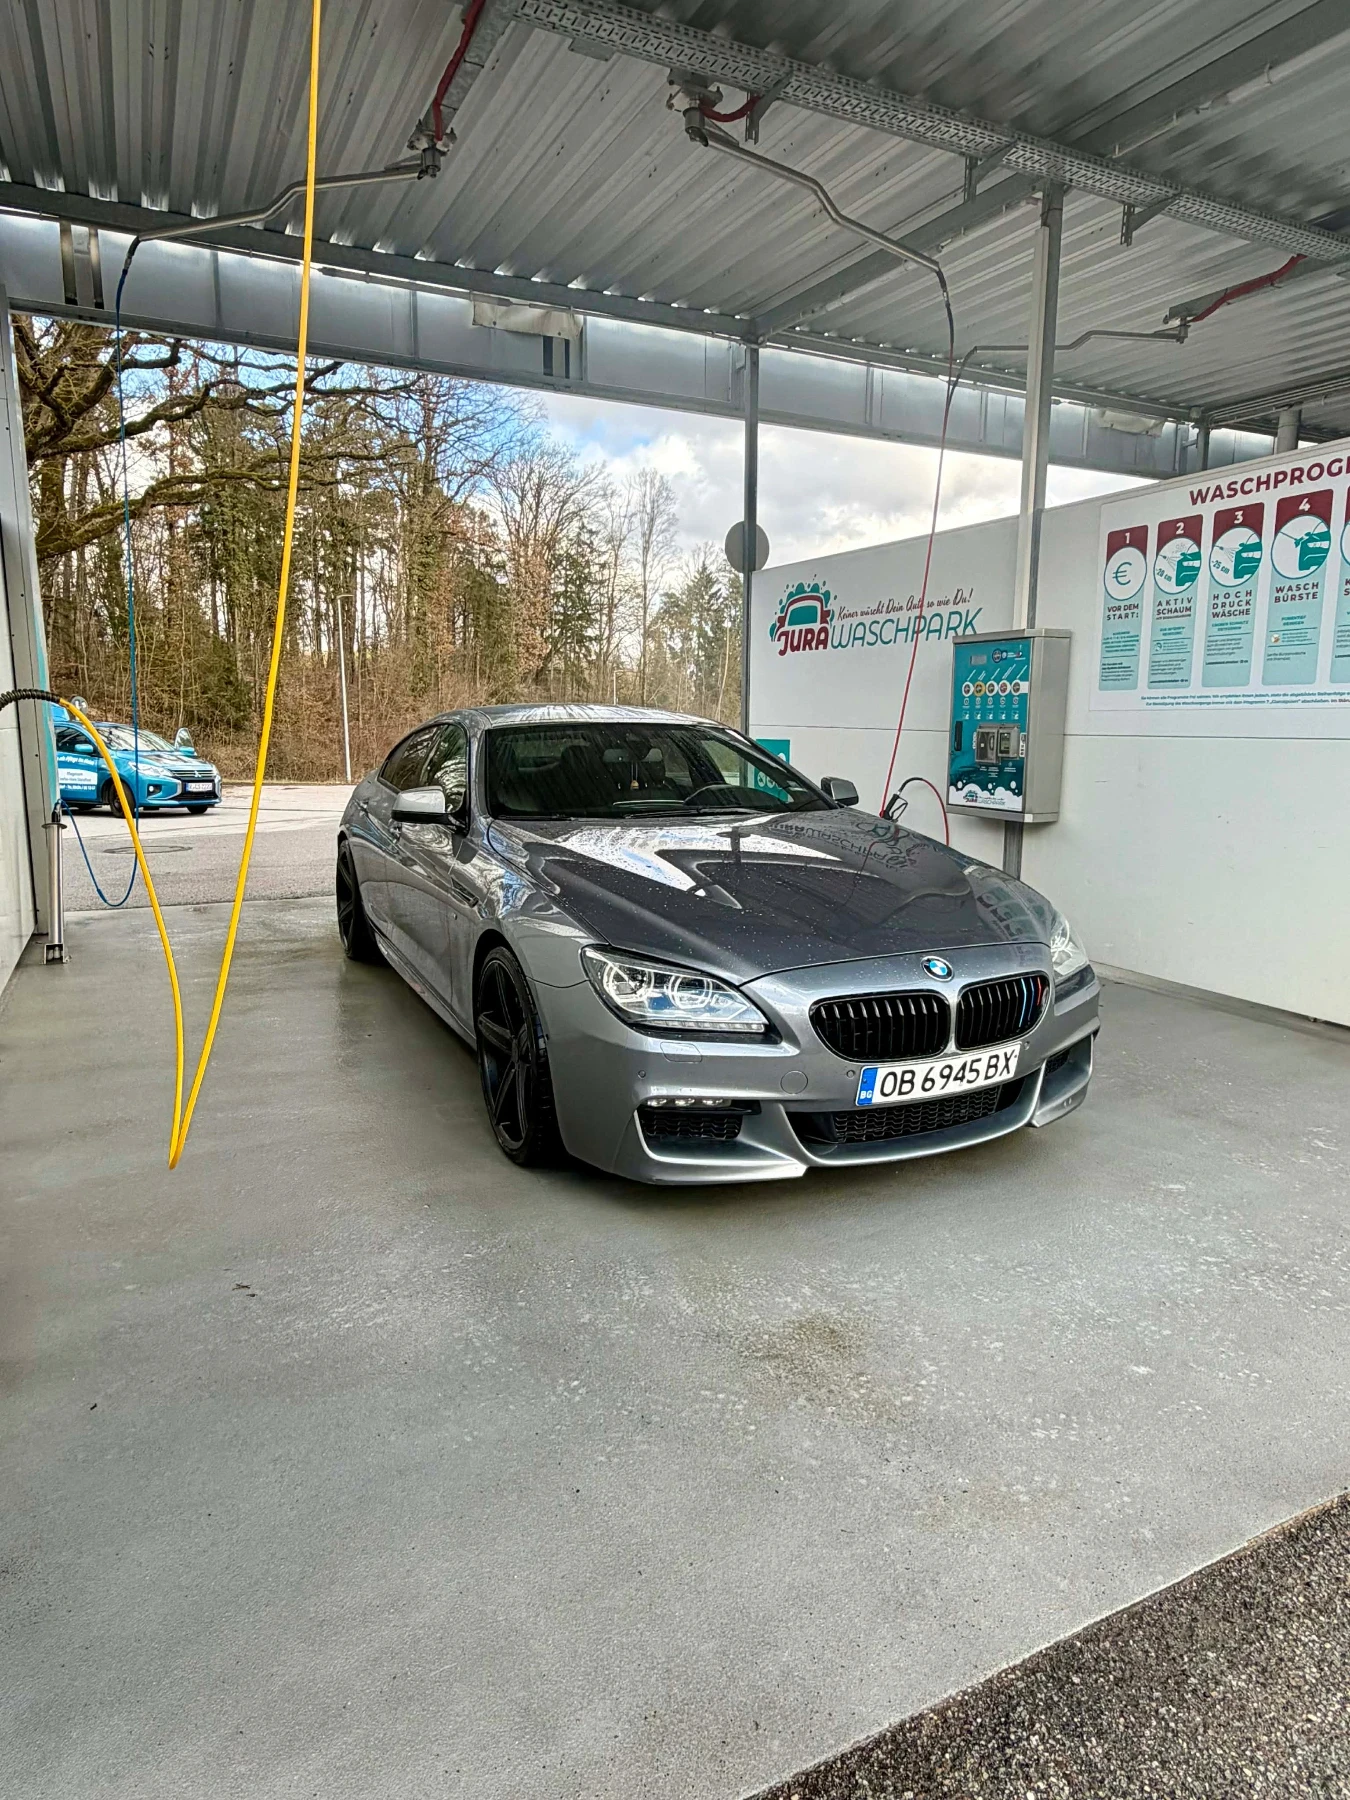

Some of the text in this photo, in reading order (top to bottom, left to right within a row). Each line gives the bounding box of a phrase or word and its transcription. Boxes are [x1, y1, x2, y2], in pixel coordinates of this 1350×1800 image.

[1298, 497, 1311, 511] 4
[1234, 511, 1243, 524] 3
[1175, 522, 1185, 534] 2
[1124, 532, 1131, 544] 1
[1275, 582, 1319, 594] WASCH
[1213, 589, 1253, 600] HOCH
[1274, 591, 1319, 603] BÜRSTE
[837, 606, 859, 621] Keiner
[859, 600, 885, 616] wäscht
[885, 598, 904, 614] Dein
[936, 595, 951, 607] wie
[952, 588, 974, 606] Du!
[1107, 603, 1139, 613] VOR DEM
[1156, 597, 1193, 607] AKTIV
[1212, 599, 1252, 610] DRUCK
[1156, 605, 1192, 616] SCHAUM
[1211, 608, 1251, 619] WÄSCHE
[879, 1049, 1015, 1098] OB 6945 BX
[860, 1091, 873, 1099] BG
